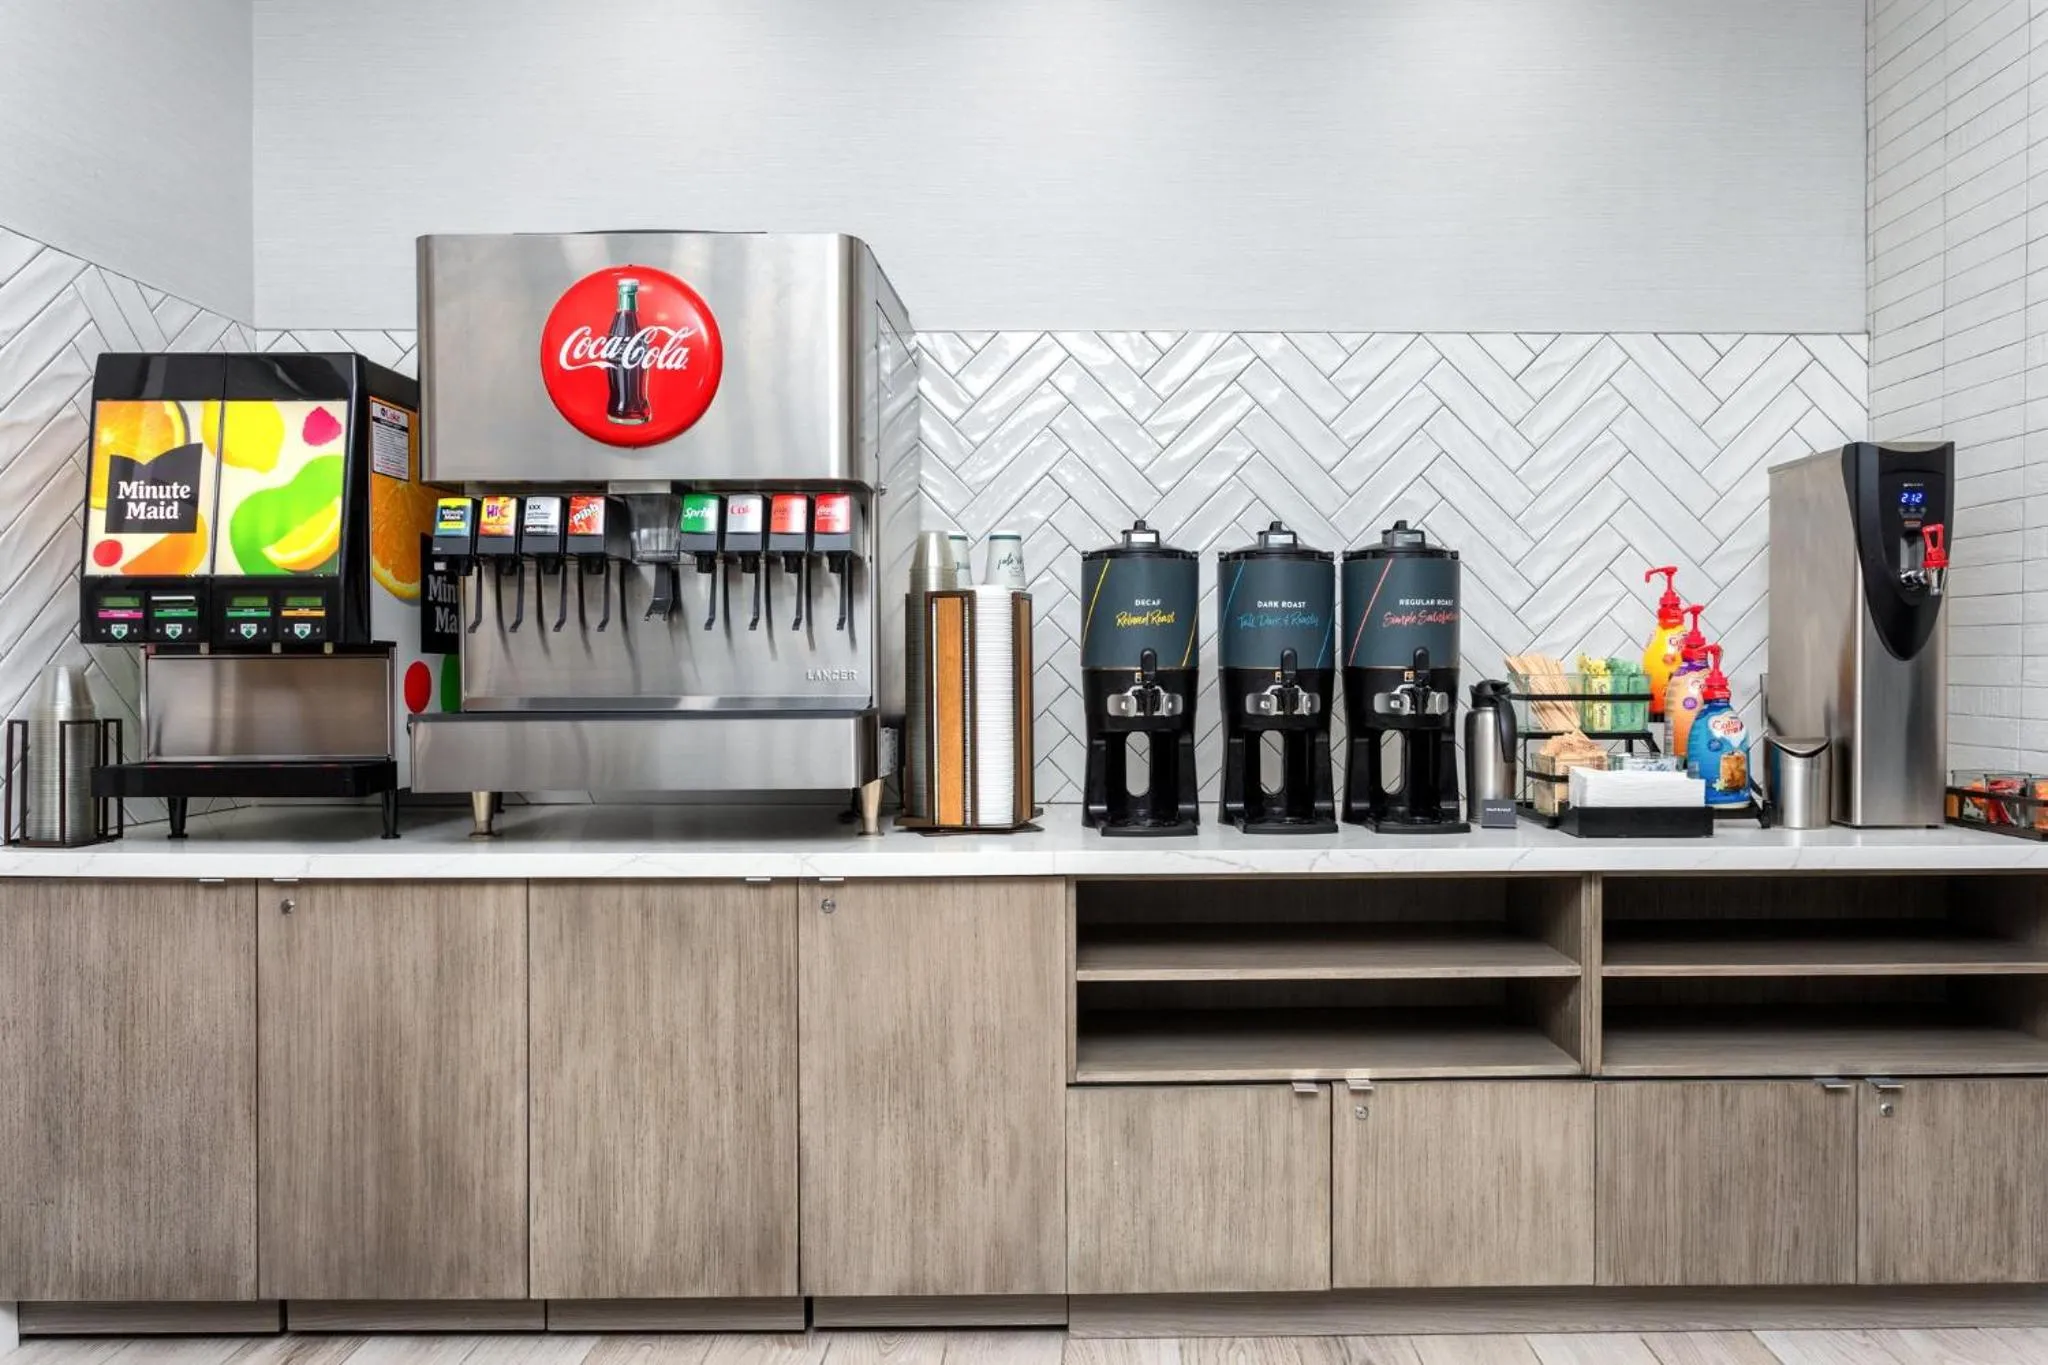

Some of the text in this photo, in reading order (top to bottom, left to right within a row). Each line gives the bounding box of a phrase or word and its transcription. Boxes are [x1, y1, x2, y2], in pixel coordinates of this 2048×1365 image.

[559, 325, 699, 371] Coca-Cola
[117, 480, 191, 499] Minute
[1901, 493, 1923, 503] 212
[124, 501, 180, 520] Maid
[427, 574, 457, 604] Min
[1135, 598, 1161, 606] DECAF
[1256, 600, 1279, 608] DARK
[1398, 598, 1435, 606] REGULAR
[434, 605, 459, 634] Ma
[805, 669, 858, 680] LANCER
